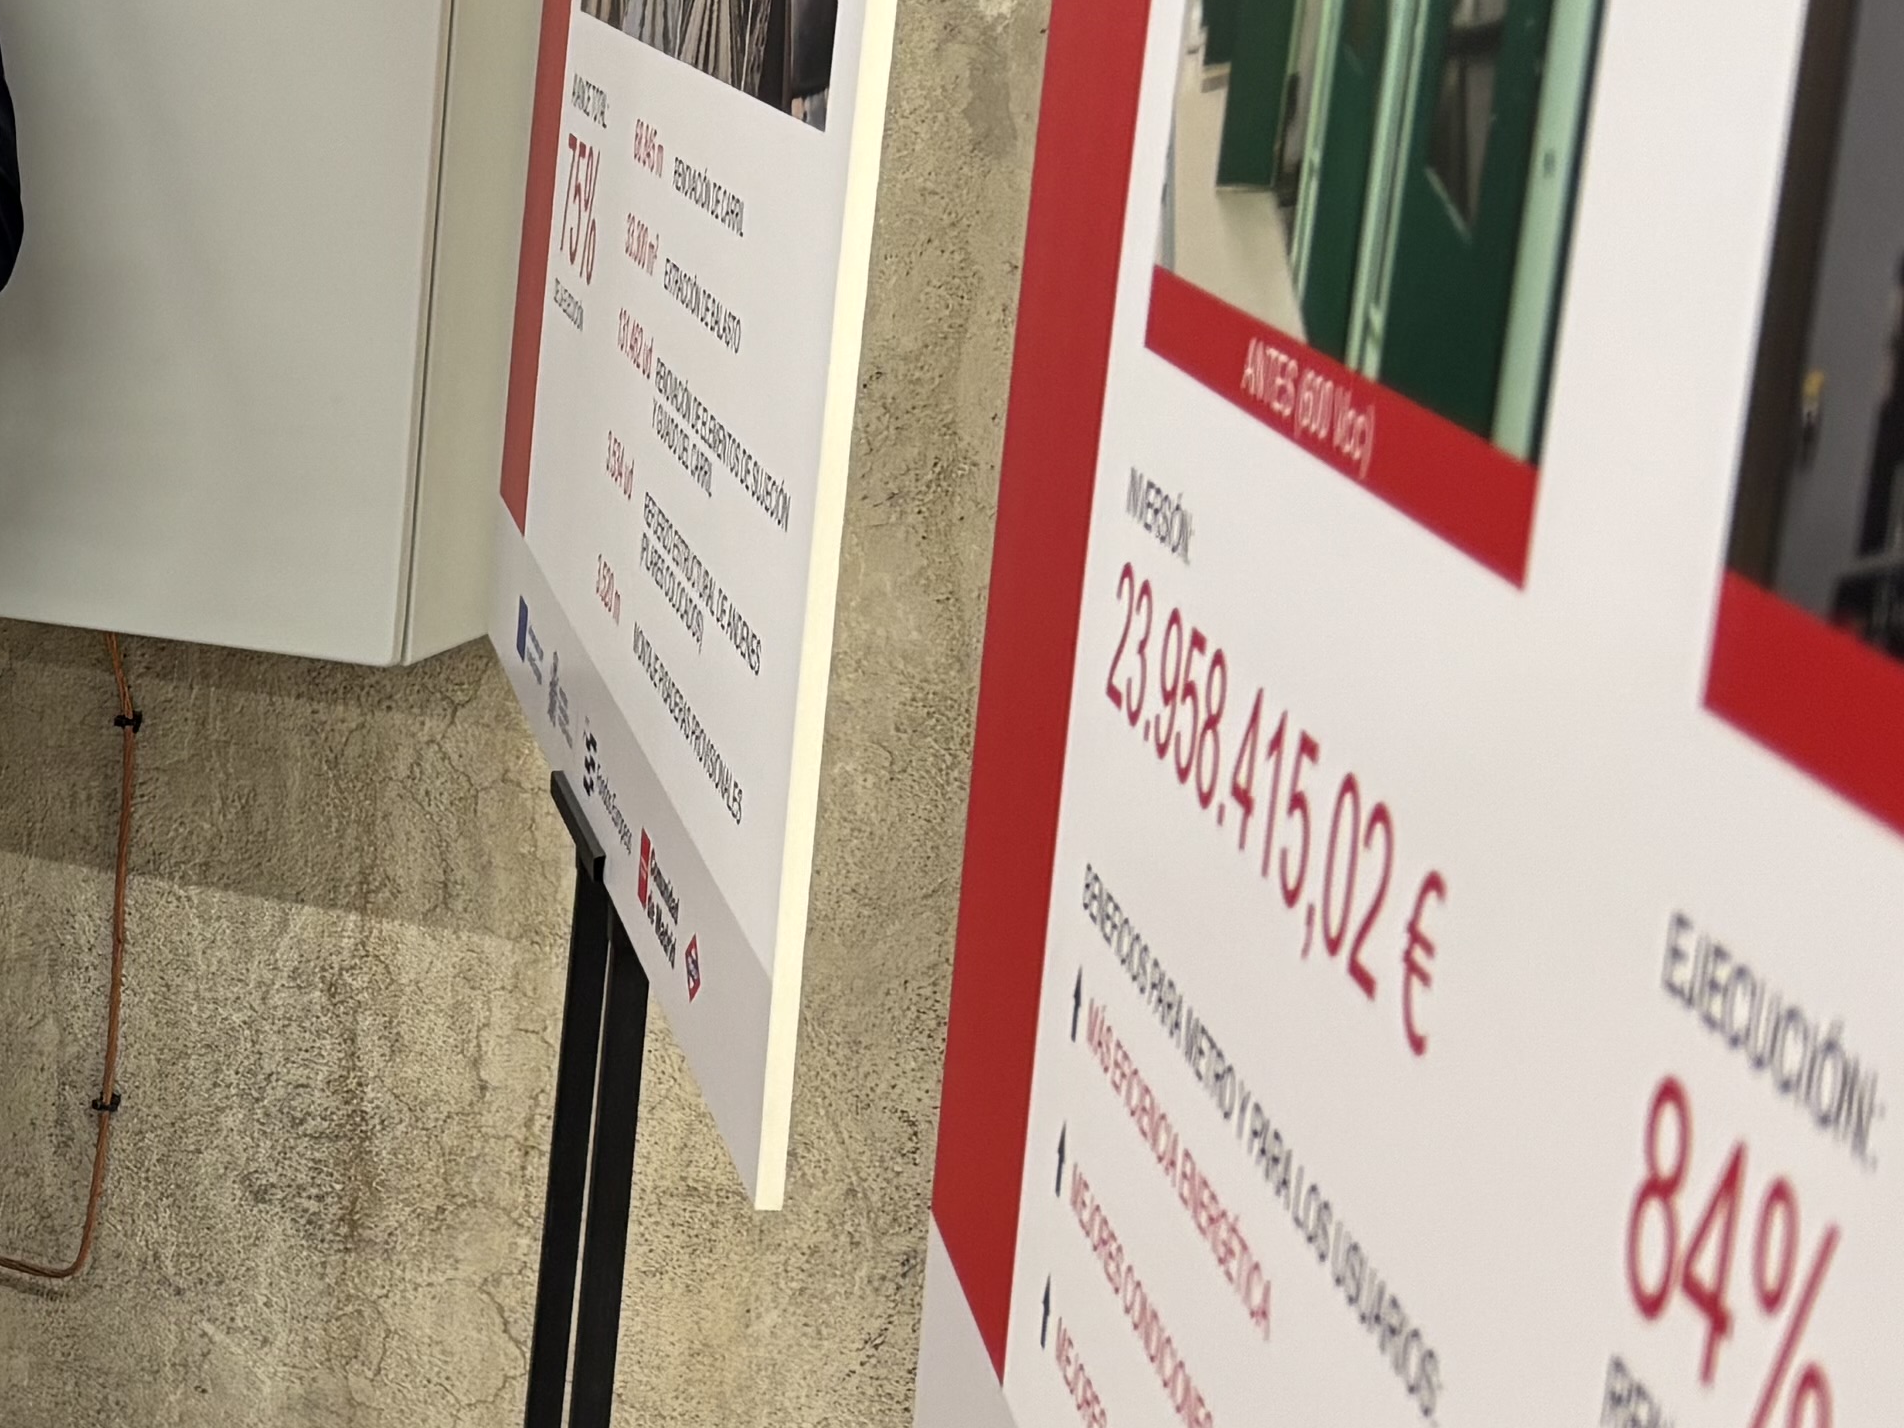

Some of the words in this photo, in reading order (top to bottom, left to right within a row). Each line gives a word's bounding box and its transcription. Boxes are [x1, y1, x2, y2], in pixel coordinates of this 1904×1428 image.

[560, 132, 600, 286] 75%
[672, 156, 710, 212] RENOVACIÓN
[710, 182, 722, 220] DE
[720, 188, 744, 238] CARRIL
[664, 258, 700, 318] EXTRACCIÓN
[700, 290, 712, 328] DE
[710, 298, 742, 354] BALASTO
[652, 398, 658, 428] Y
[690, 444, 712, 498] CARRIL
[654, 356, 692, 424] RENOVACIÓN
[690, 396, 702, 434] DE
[700, 406, 740, 478] ELEMENTOS
[740, 448, 752, 492] DE
[750, 460, 790, 532] SUJECIÓN
[1242, 340, 1298, 416] ANTES
[1298, 370, 1334, 440] (600
[1332, 388, 1374, 480] Vcc)
[644, 492, 674, 556] REFUERZO
[672, 530, 716, 616] ESTRUCTURAL
[716, 588, 728, 630] DE
[726, 602, 762, 676] ANDENES
[632, 622, 660, 688] MONTAJE
[690, 714, 742, 826] PROVISIONALES
[1106, 562, 1394, 1000] 23.958.415,02
[1402, 870, 1446, 1056] €
[646, 890, 656, 926] de
[654, 902, 676, 970] Madrid
[650, 848, 680, 926] Comunidad
[1662, 912, 1876, 1162] EJECUCIÓN:
[1082, 864, 1150, 994] BENEFICIOS
[1150, 958, 1182, 1038] PARA
[1184, 1008, 1236, 1120] METRO
[1236, 1080, 1252, 1140] Y
[1250, 1102, 1292, 1196] PARA
[1292, 1168, 1332, 1262] LOS
[1334, 1242, 1438, 1418] USUARIOS:
[1086, 998, 1112, 1074] MÁS
[1112, 1038, 1178, 1176] EFICIENCIA
[1178, 1148, 1270, 1338] ENERGÉTICA
[1070, 1164, 1124, 1296] MEJORES
